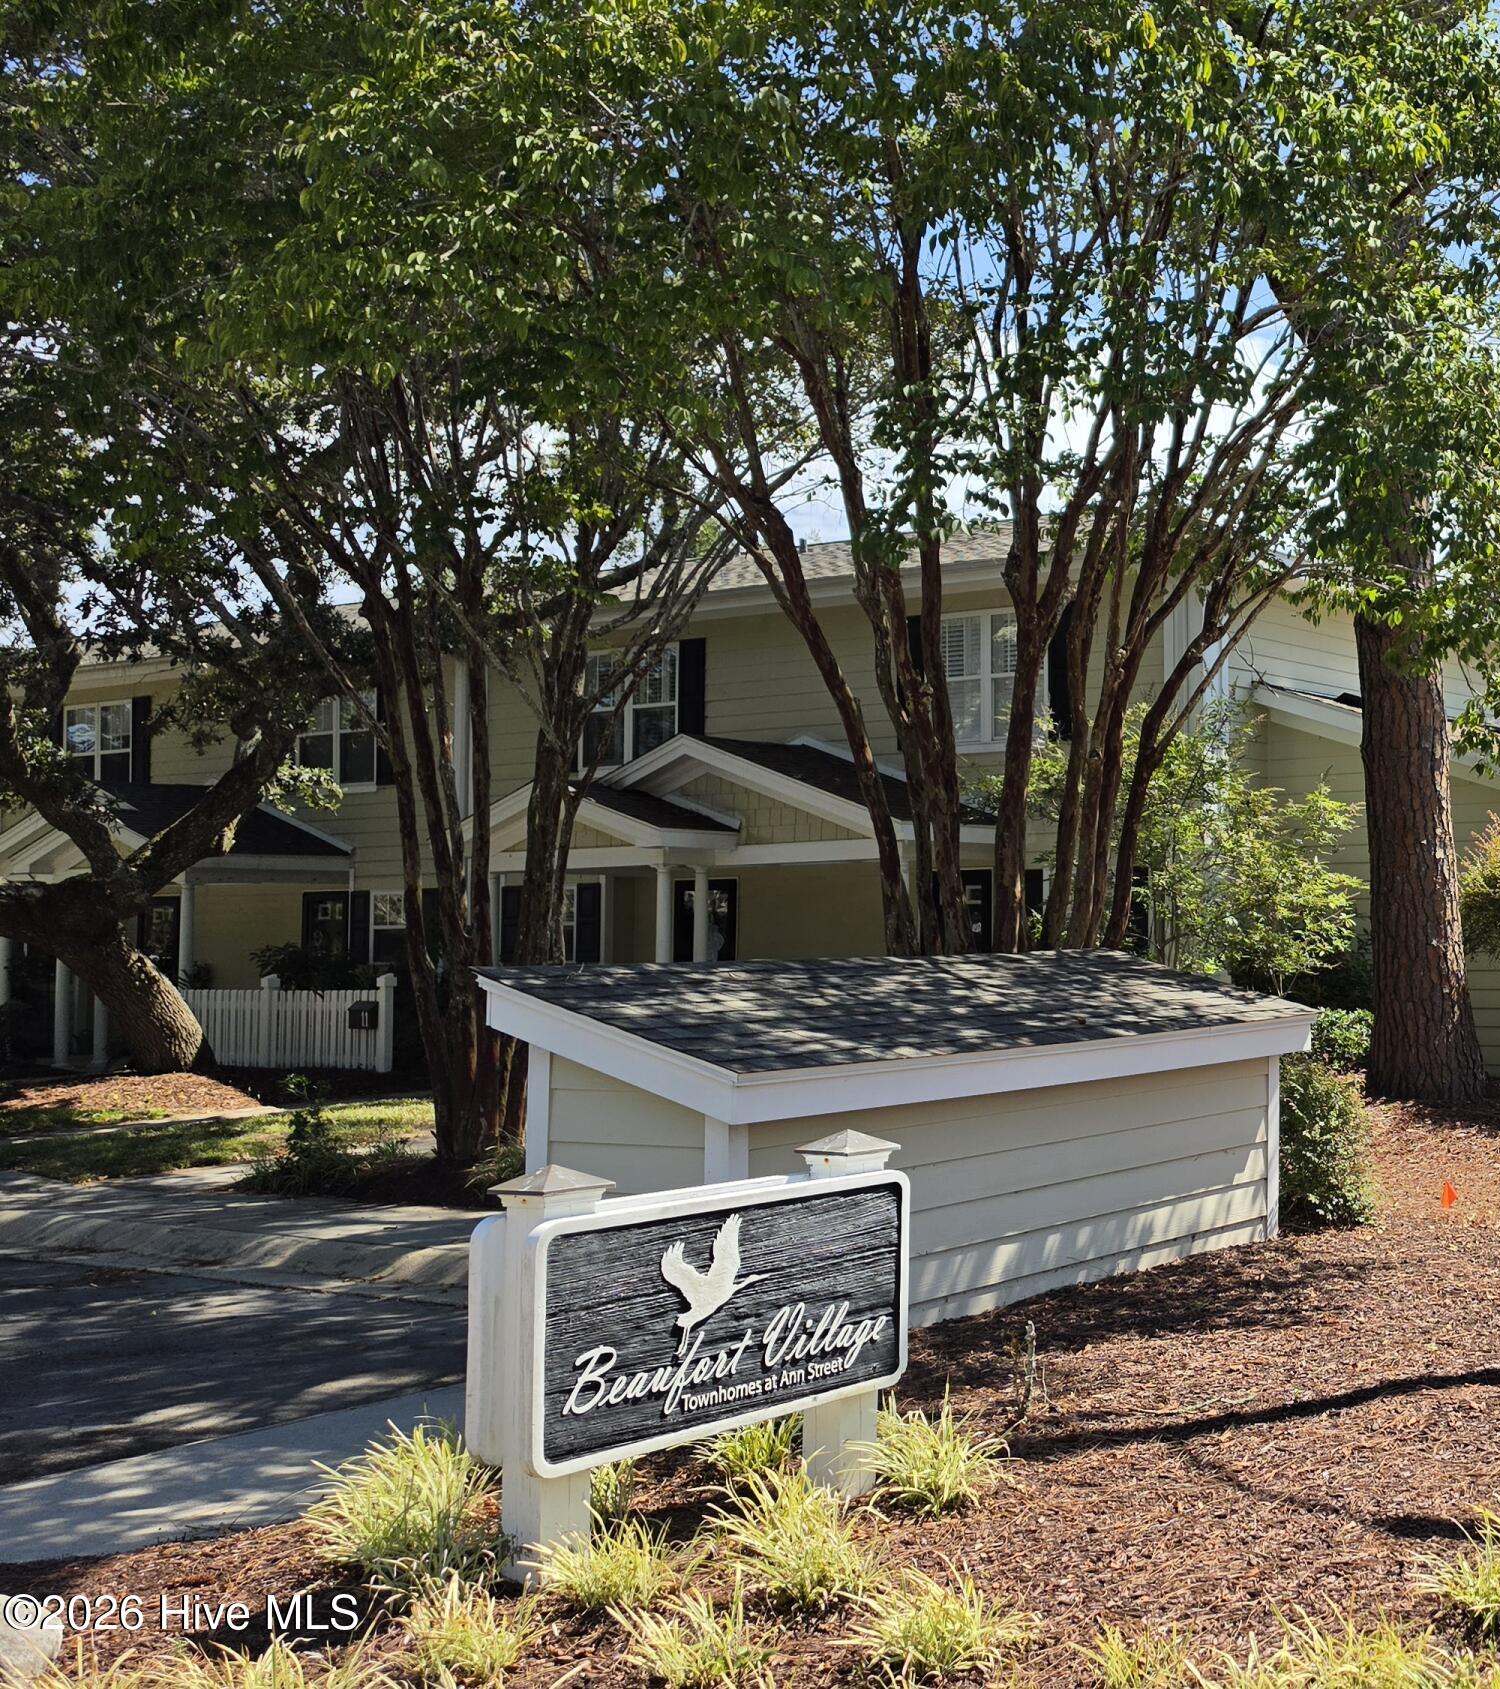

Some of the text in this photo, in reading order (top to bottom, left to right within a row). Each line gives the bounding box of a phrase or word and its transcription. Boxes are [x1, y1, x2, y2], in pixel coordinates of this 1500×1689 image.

[562, 1301, 893, 1415] Beaufort Village
[681, 1357, 845, 1411] Townhomes at Ann Street
